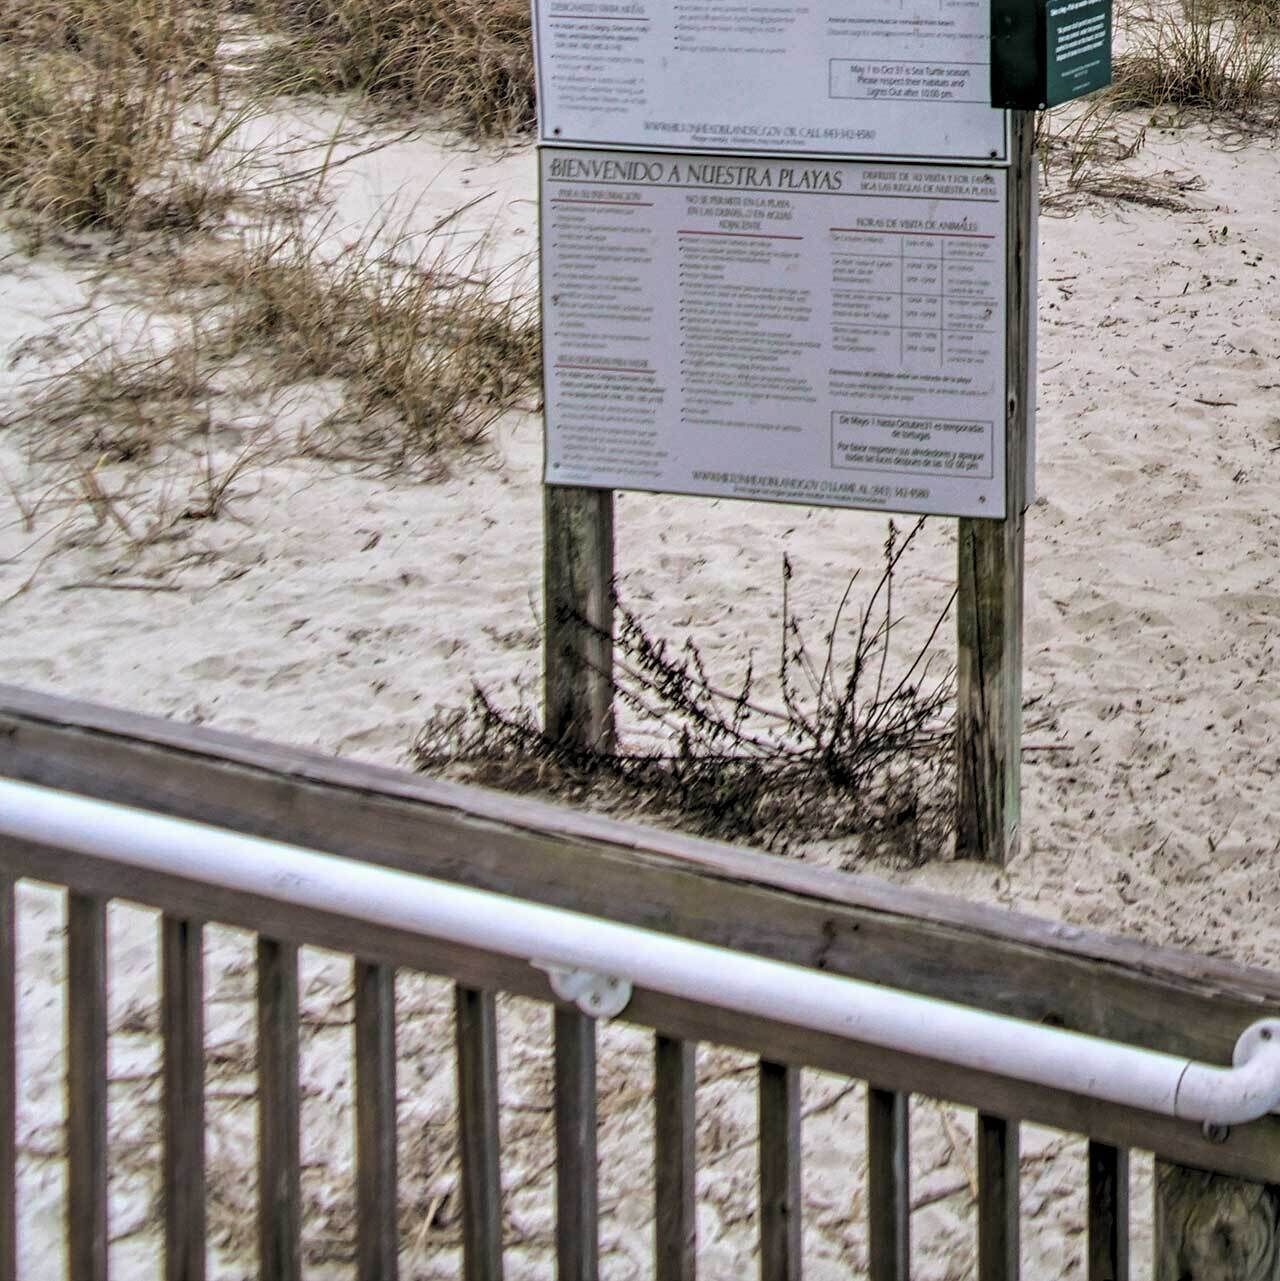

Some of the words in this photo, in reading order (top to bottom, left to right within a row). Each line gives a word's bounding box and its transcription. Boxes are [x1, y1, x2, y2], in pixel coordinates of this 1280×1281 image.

[549, 158, 662, 181] BIENVENIDO
[667, 163, 681, 182] A
[686, 163, 772, 186] NUESTRA
[778, 168, 844, 191] PLAYAS
